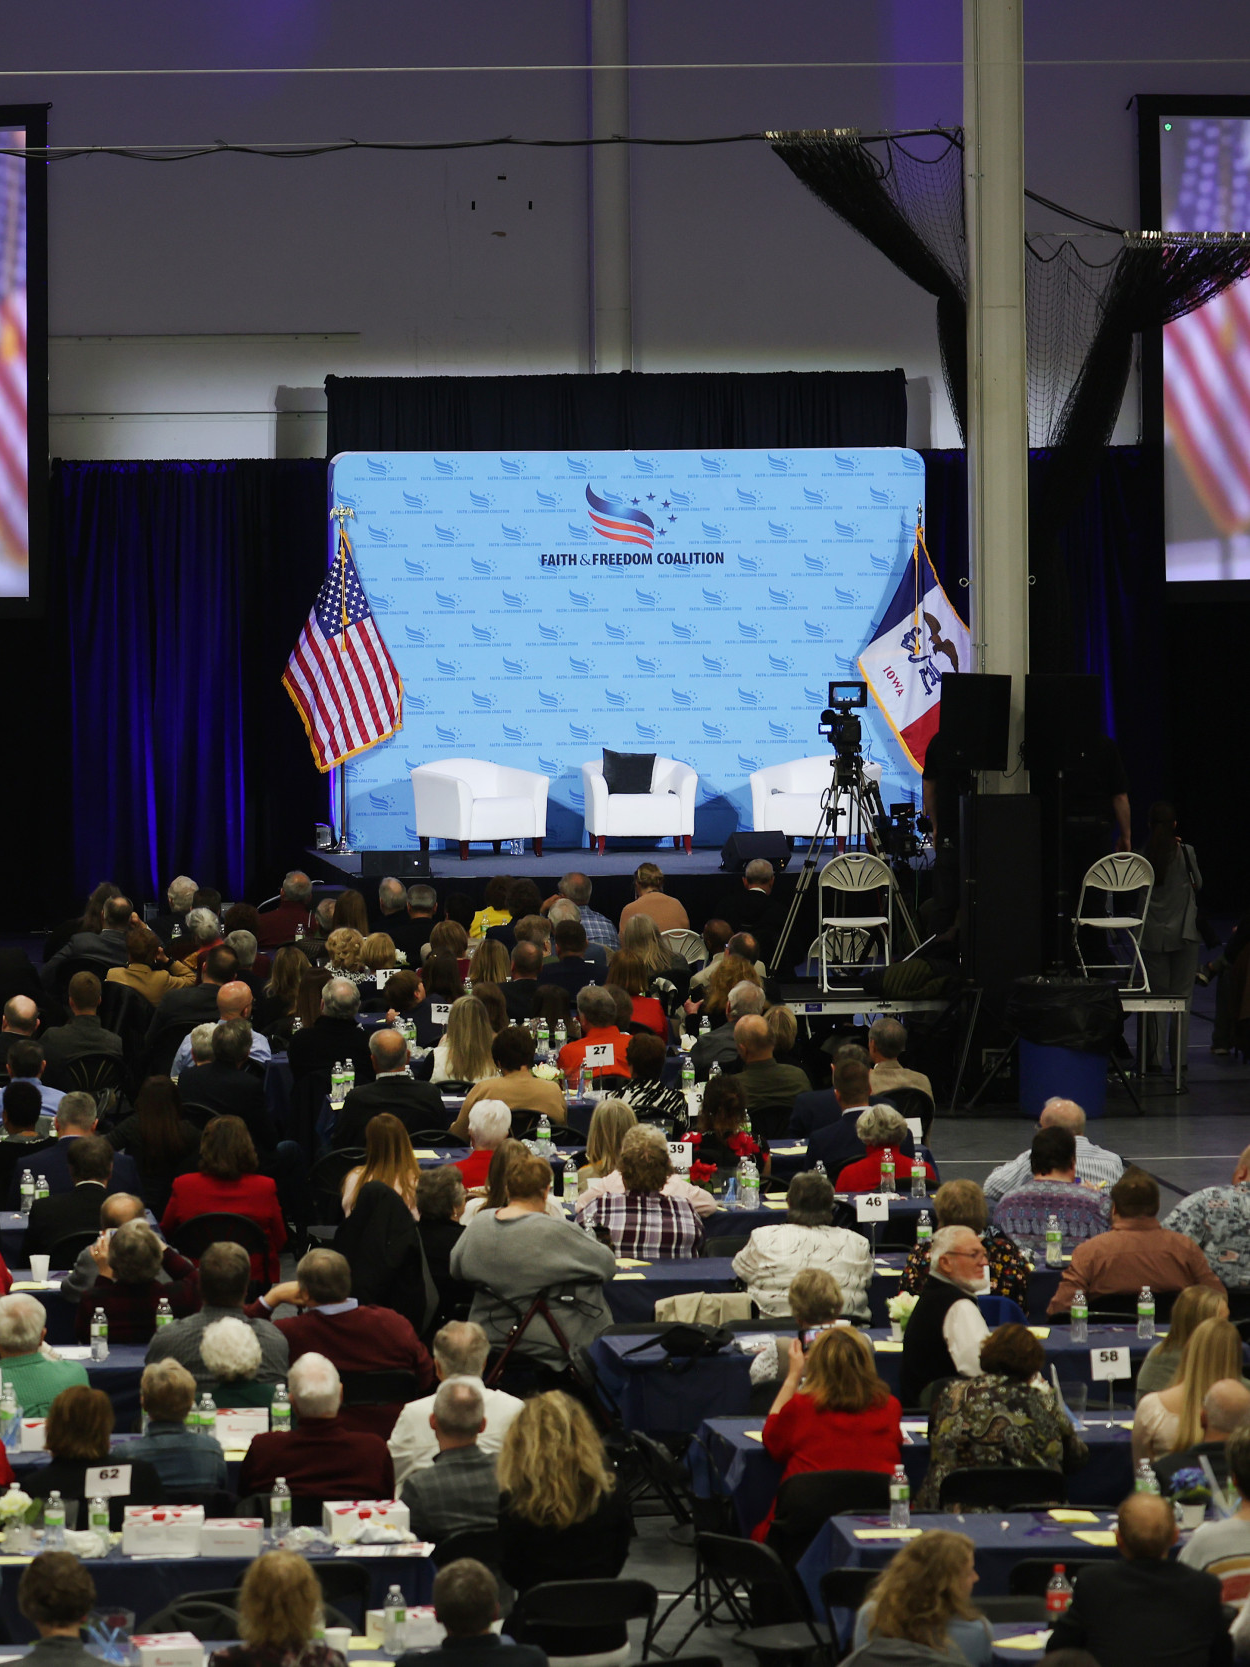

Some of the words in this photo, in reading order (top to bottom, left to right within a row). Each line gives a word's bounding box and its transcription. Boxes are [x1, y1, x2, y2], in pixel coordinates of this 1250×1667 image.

[541, 554, 577, 566] FAITH
[579, 554, 592, 566] &
[592, 552, 652, 566] FREEDOM
[656, 552, 724, 565] COALITION
[883, 666, 904, 697] IOWA
[437, 1005, 449, 1013] 22
[594, 1046, 606, 1055] 27
[670, 1145, 684, 1153] 39
[866, 1197, 881, 1206] 46
[1100, 1351, 1118, 1362] 58
[100, 1469, 119, 1479] 62
